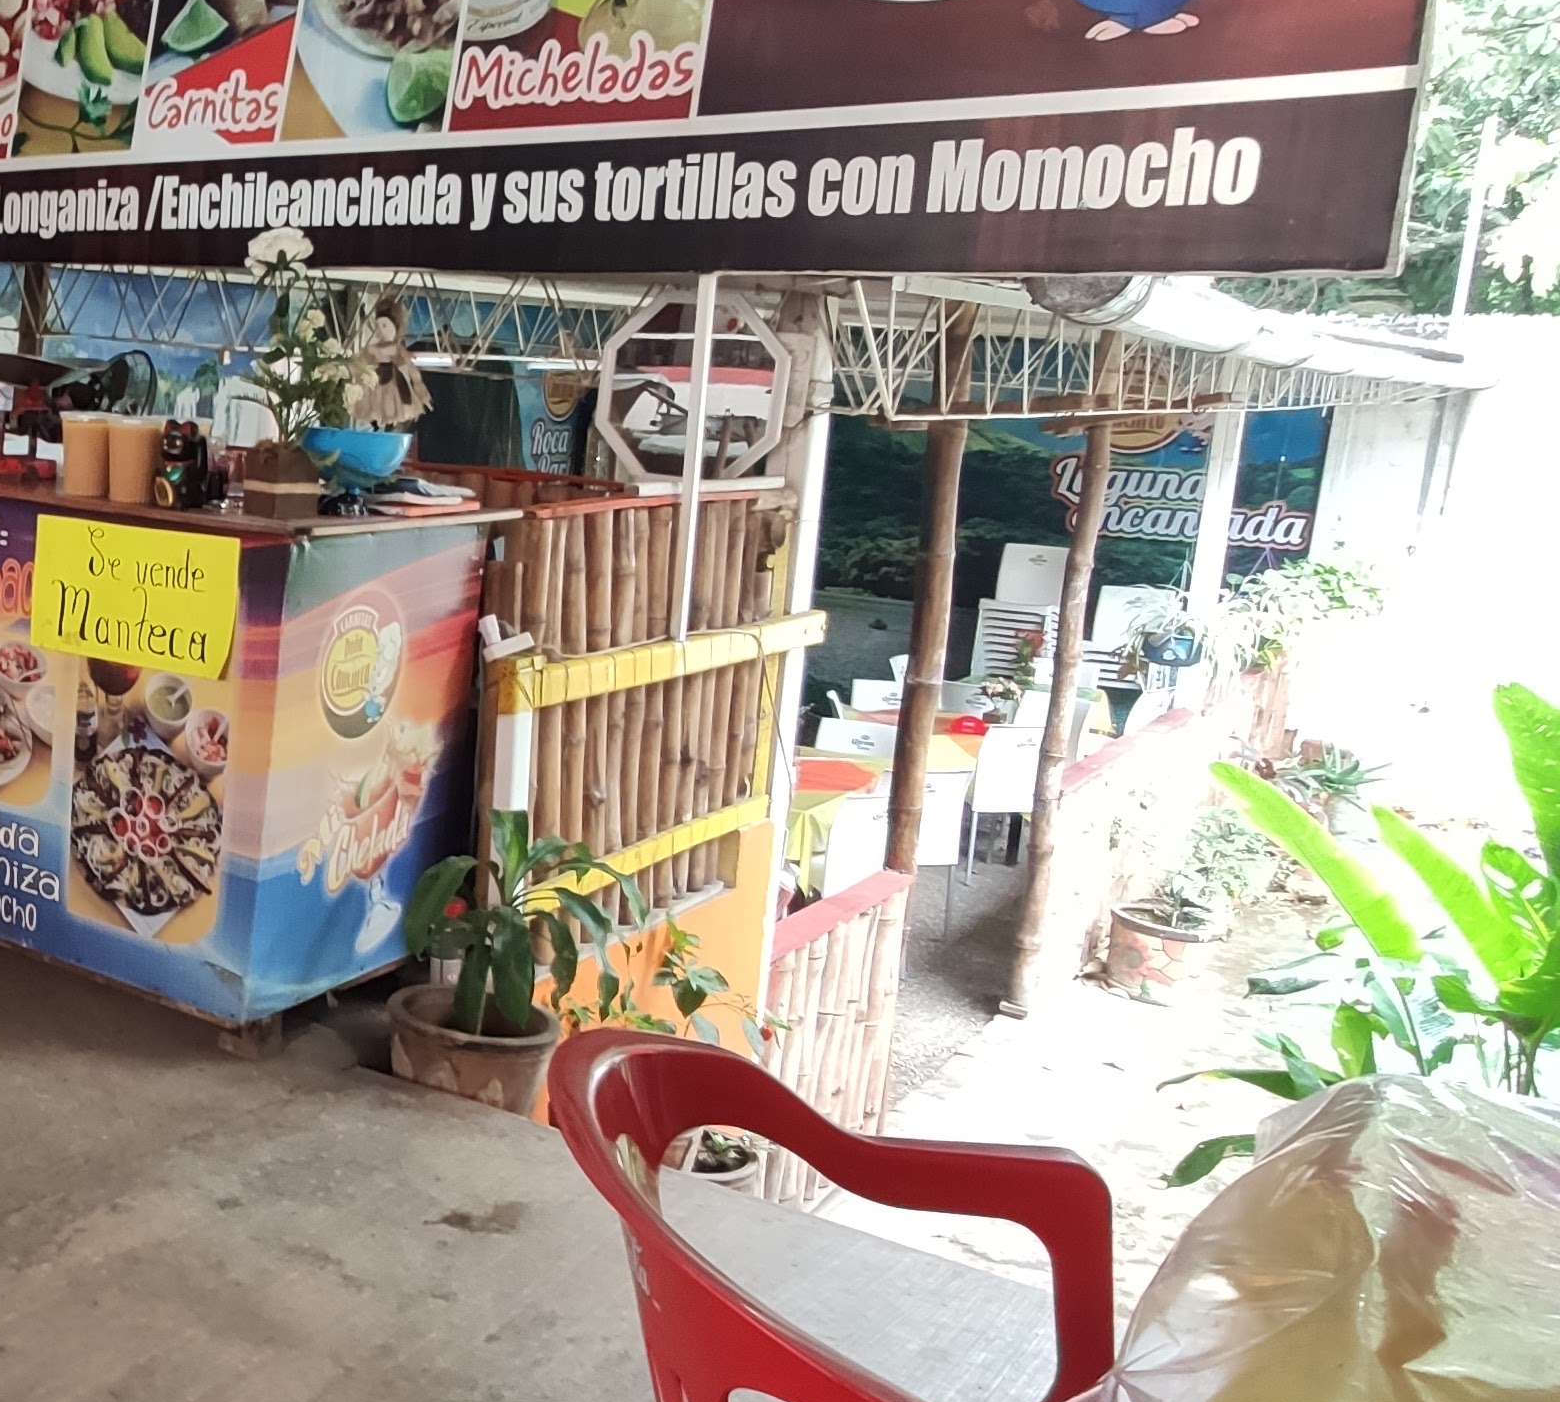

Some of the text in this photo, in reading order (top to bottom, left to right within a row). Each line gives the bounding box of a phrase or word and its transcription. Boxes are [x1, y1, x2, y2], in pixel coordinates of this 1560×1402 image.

[461, 33, 695, 102] Micheladas
[146, 80, 280, 130] Carnitas
[144, 164, 462, 232] /Enchileanchada
[470, 172, 498, 231] y
[502, 168, 585, 225] sus
[593, 152, 798, 224] tortillas
[807, 152, 916, 219] con
[927, 128, 1263, 215] Momocho
[532, 421, 569, 455] Roca
[1071, 504, 1310, 545] ncanada
[87, 525, 206, 593] Se vende
[51, 579, 207, 664] Manteca
